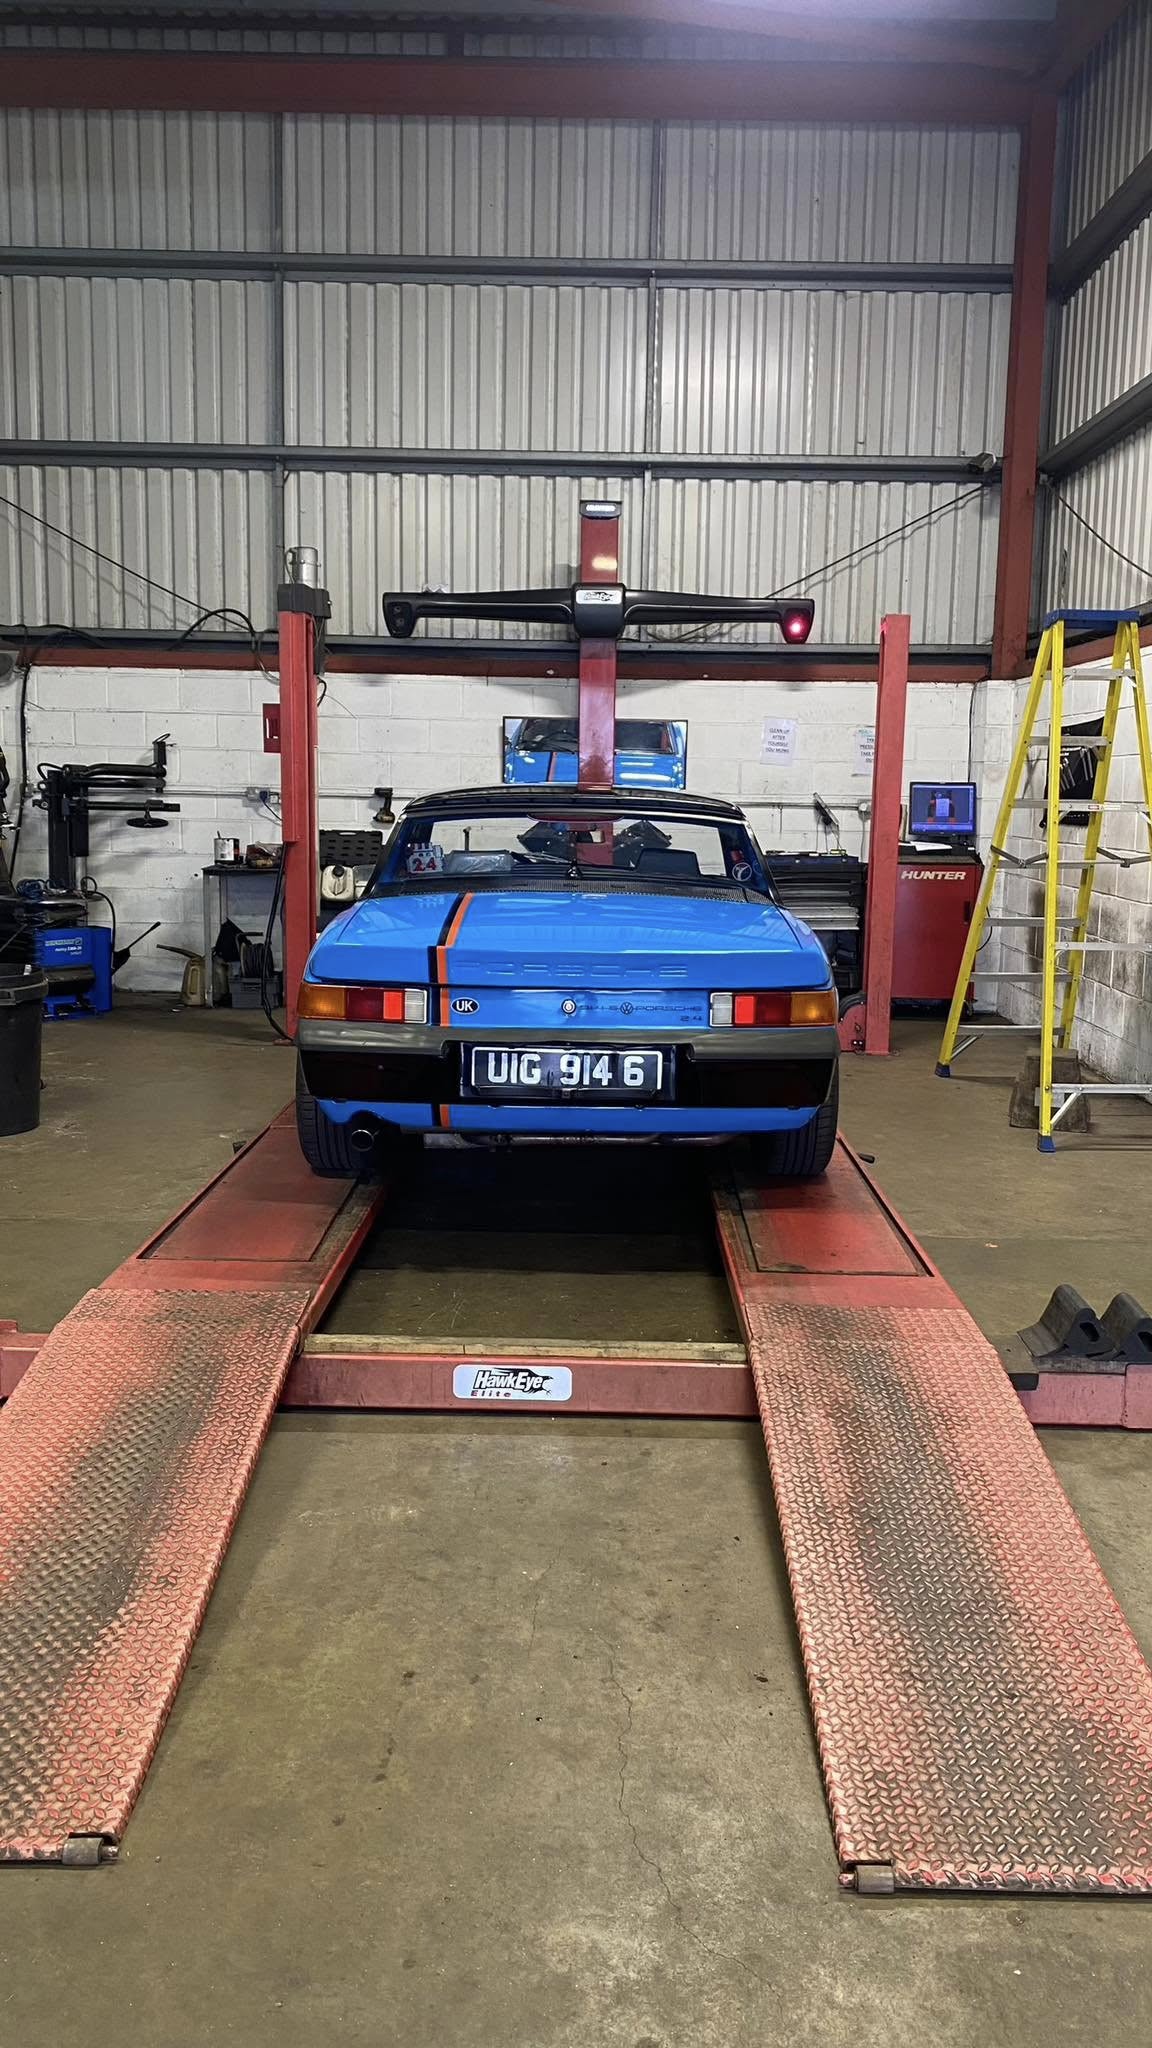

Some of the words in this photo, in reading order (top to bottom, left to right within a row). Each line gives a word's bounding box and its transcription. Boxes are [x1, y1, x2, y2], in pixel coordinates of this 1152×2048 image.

[901, 870, 967, 880] HUNTER
[456, 1000, 474, 1012] UK
[487, 1052, 542, 1085] UIG
[559, 1053, 613, 1086] 914
[472, 1369, 544, 1393] HawkEye
[470, 1390, 512, 1398] Elite
